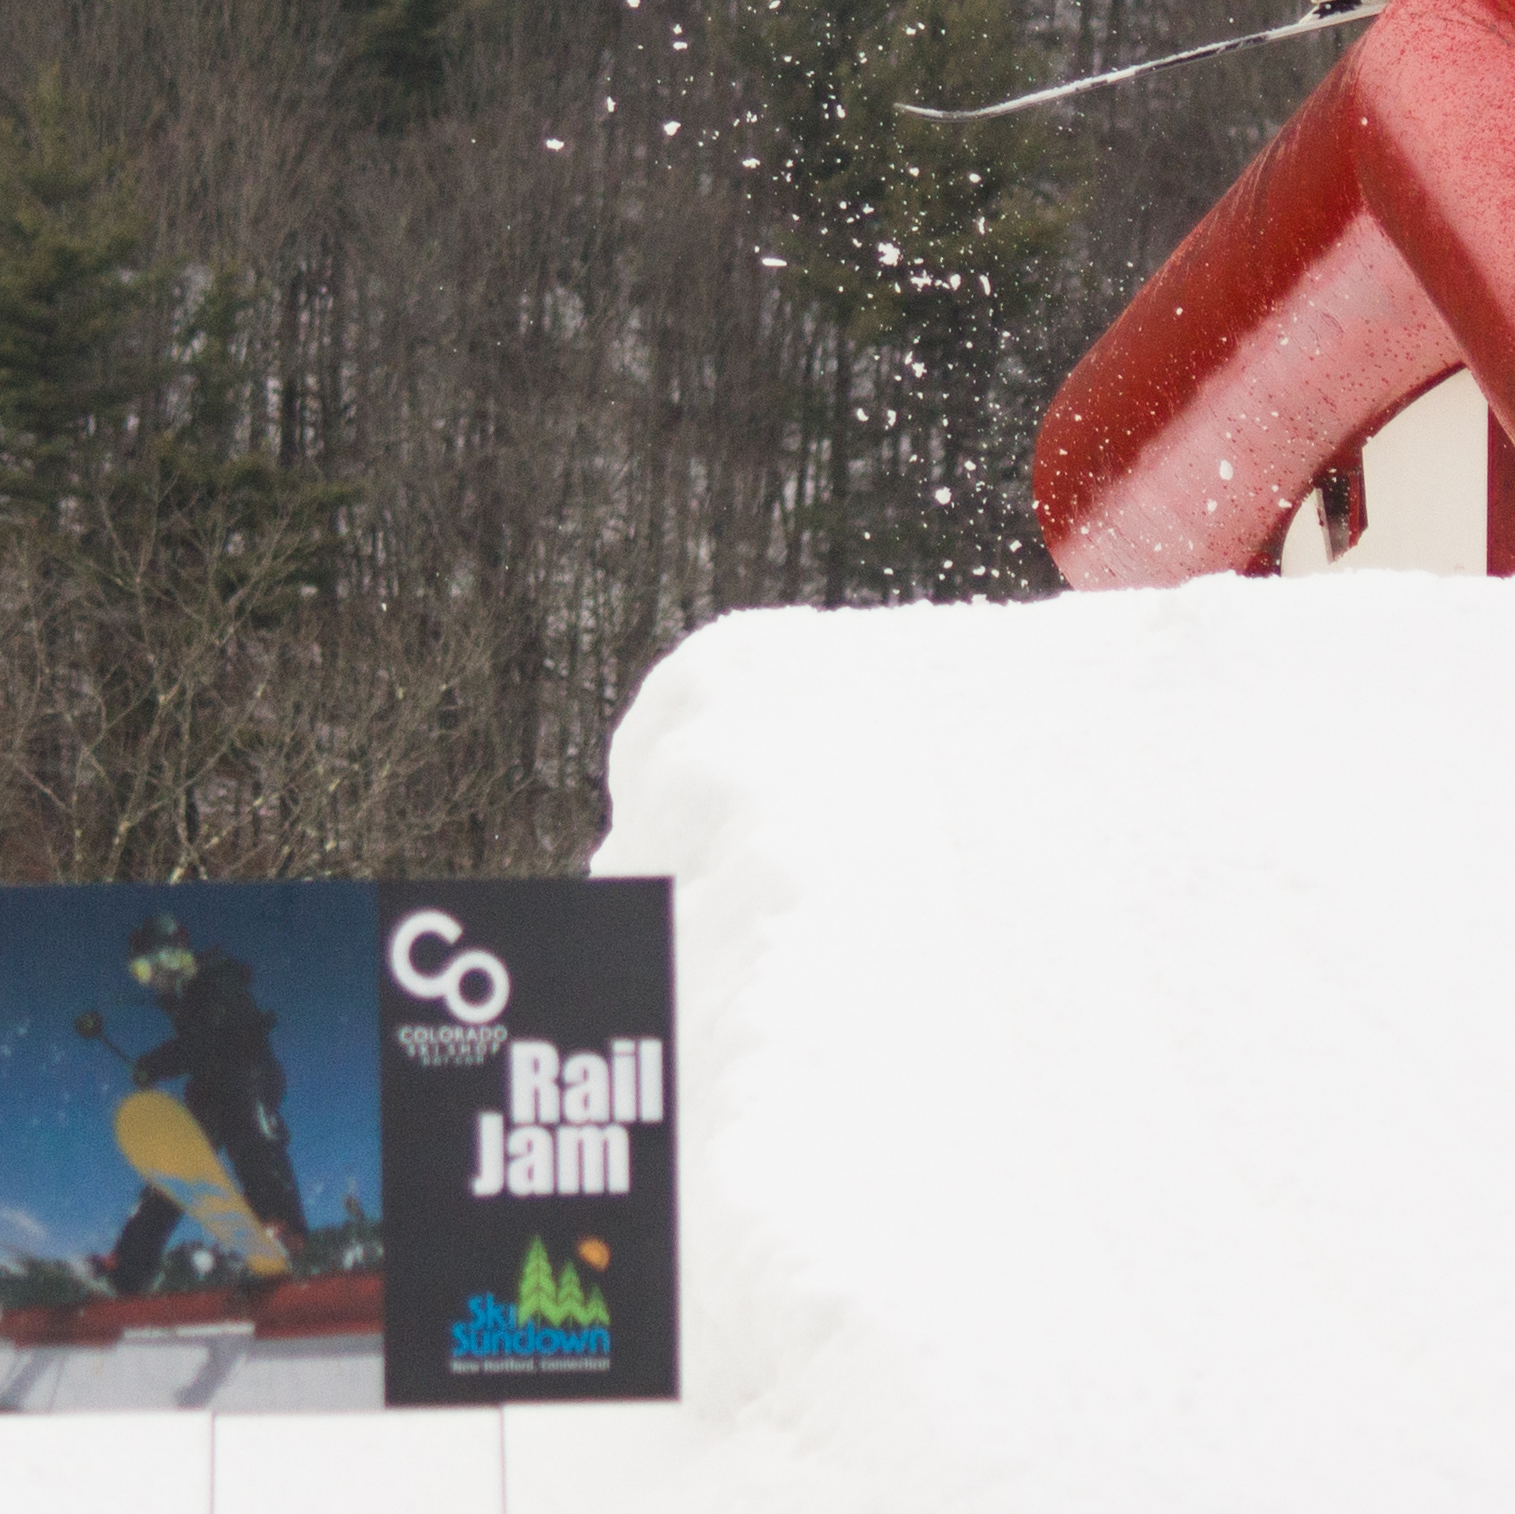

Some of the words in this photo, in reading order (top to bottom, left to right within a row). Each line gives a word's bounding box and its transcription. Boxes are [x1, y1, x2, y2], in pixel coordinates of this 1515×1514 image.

[397, 1024, 507, 1044] COLORADO
[510, 1038, 664, 1125] Rail
[472, 1111, 630, 1197] Jam
[467, 1292, 517, 1331] Ski
[452, 1317, 611, 1357] Sundown
